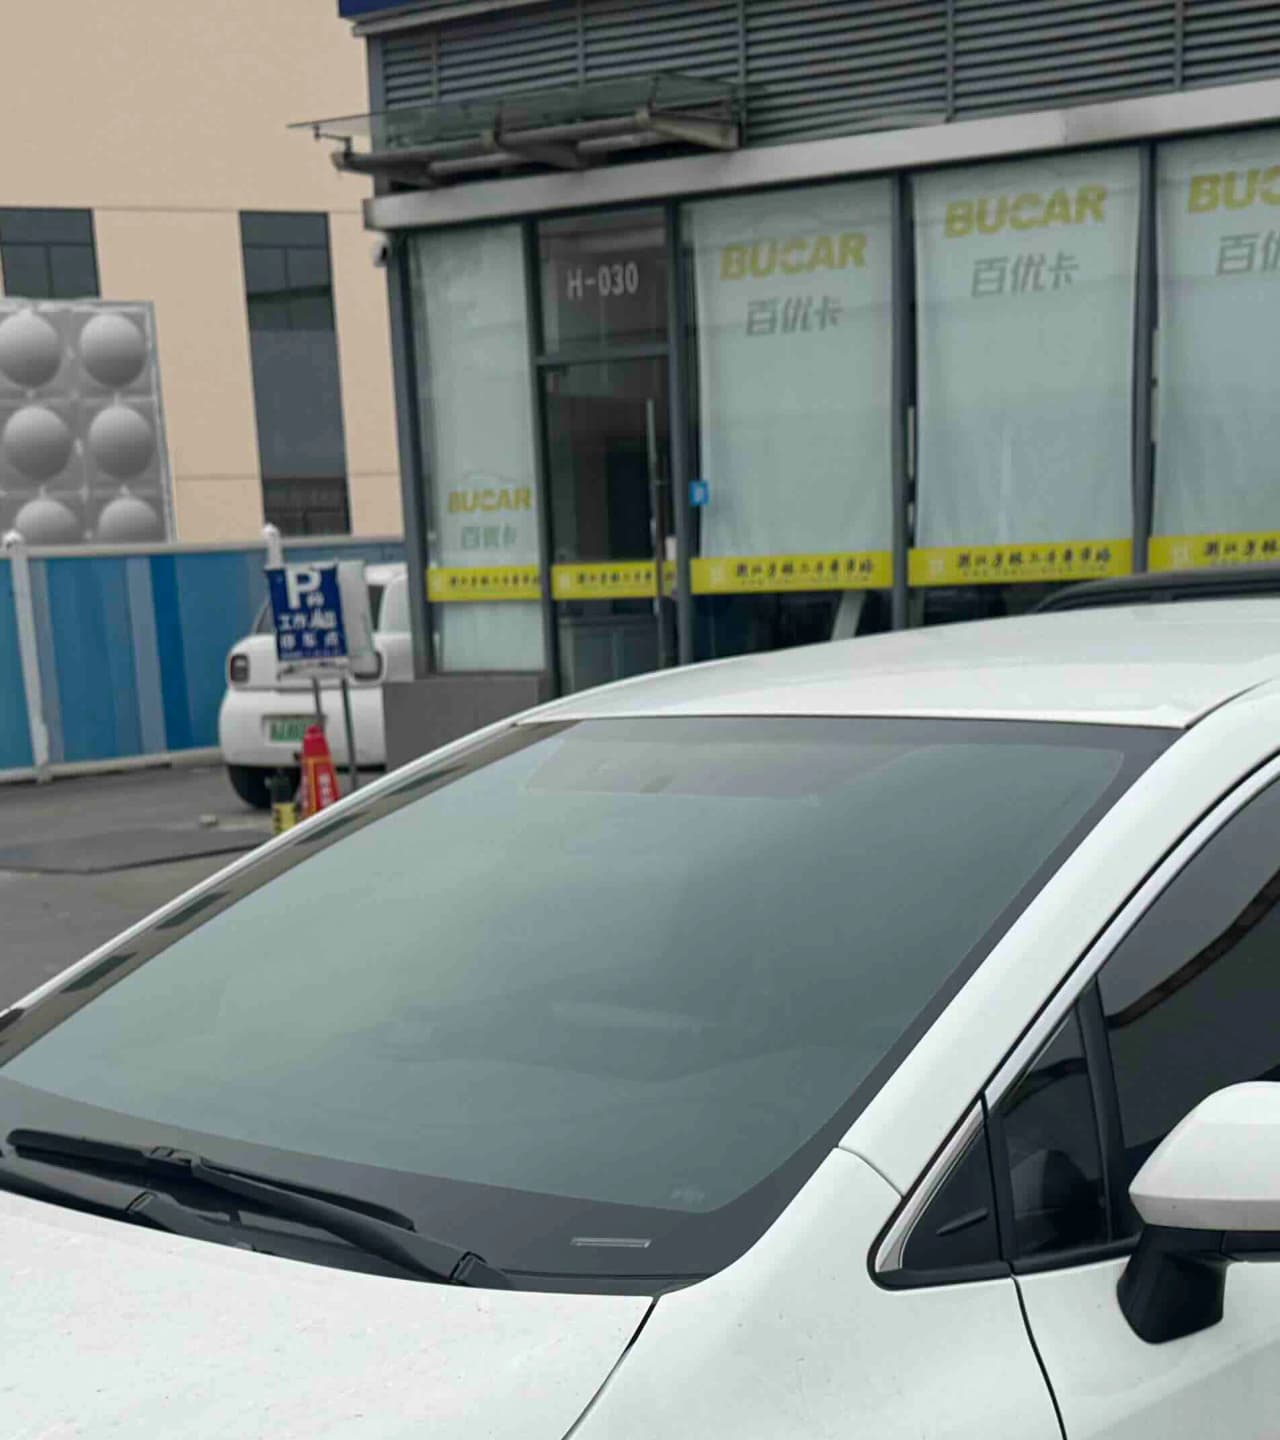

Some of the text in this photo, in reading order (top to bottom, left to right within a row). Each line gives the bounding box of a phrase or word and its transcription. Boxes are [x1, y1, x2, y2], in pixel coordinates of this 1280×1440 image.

[944, 183, 1108, 239] BUCAR
[721, 233, 867, 280] BUCAR
[972, 250, 1080, 298] 百优卡
[567, 262, 639, 299] H-030
[746, 296, 843, 336] 百优卡
[286, 566, 321, 610] P
